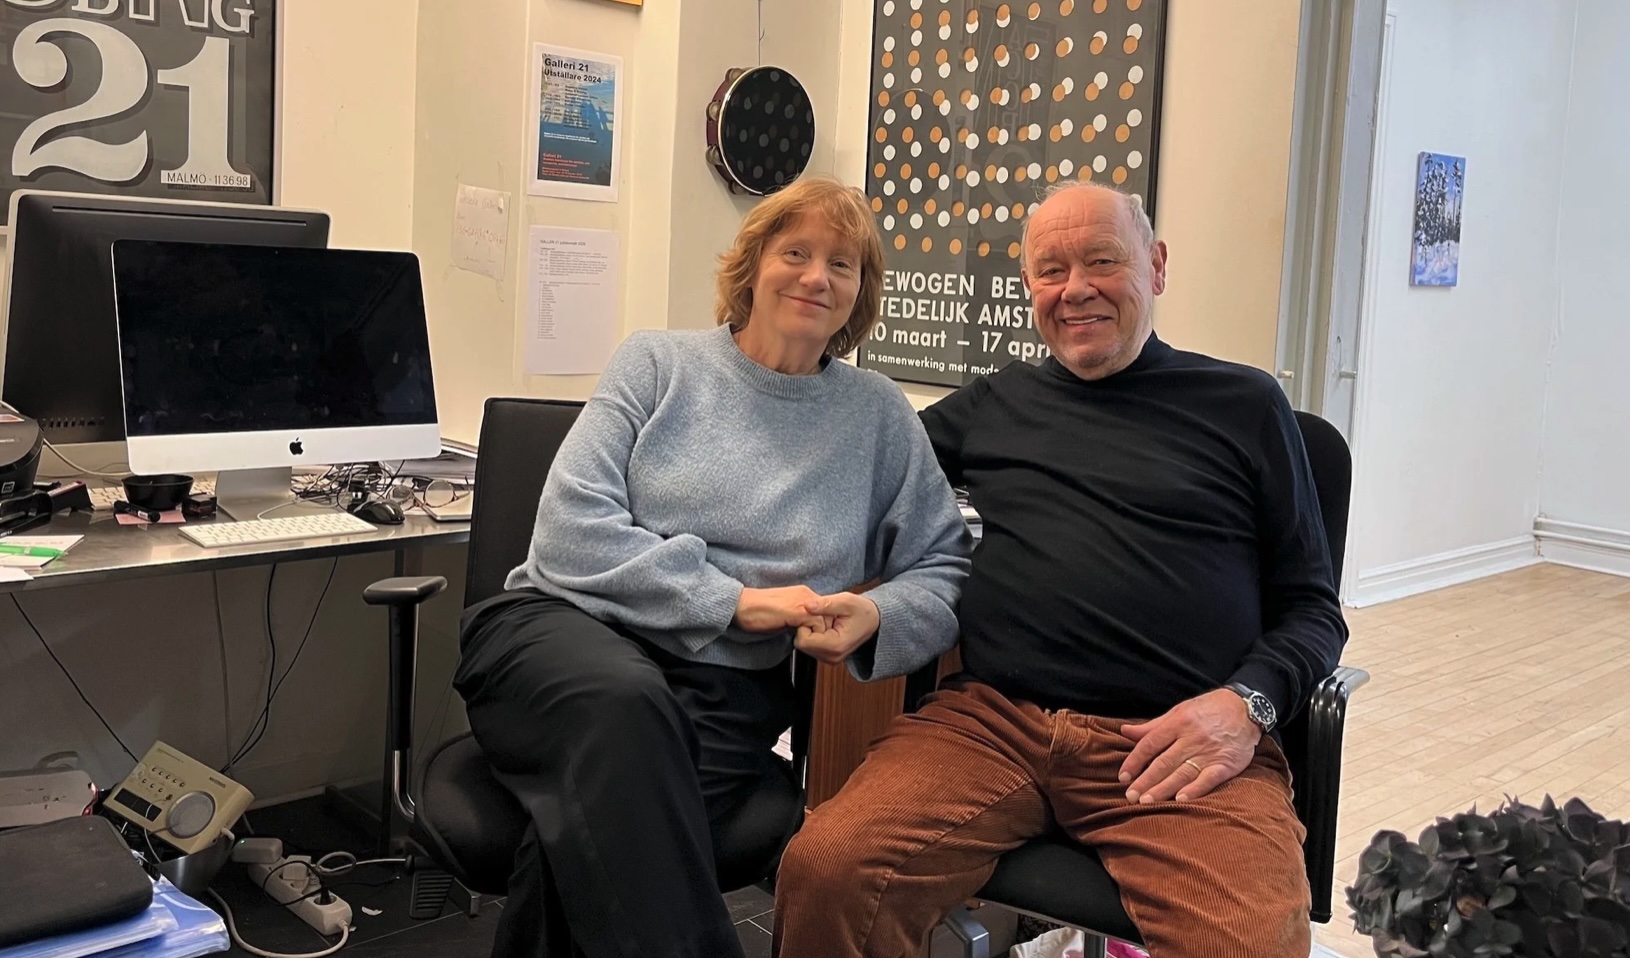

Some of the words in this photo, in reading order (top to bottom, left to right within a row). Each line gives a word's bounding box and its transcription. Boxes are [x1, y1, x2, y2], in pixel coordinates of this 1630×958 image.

[544, 57, 576, 70] Galleri
[578, 62, 589, 73] 21
[583, 74, 602, 84] 2024
[12, 17, 251, 188] 21
[167, 171, 207, 184] MALMÖ
[892, 328, 947, 349] maart
[982, 331, 1003, 353] 17
[867, 350, 876, 361] in
[877, 353, 945, 372] samenwerking
[948, 362, 968, 373] met
